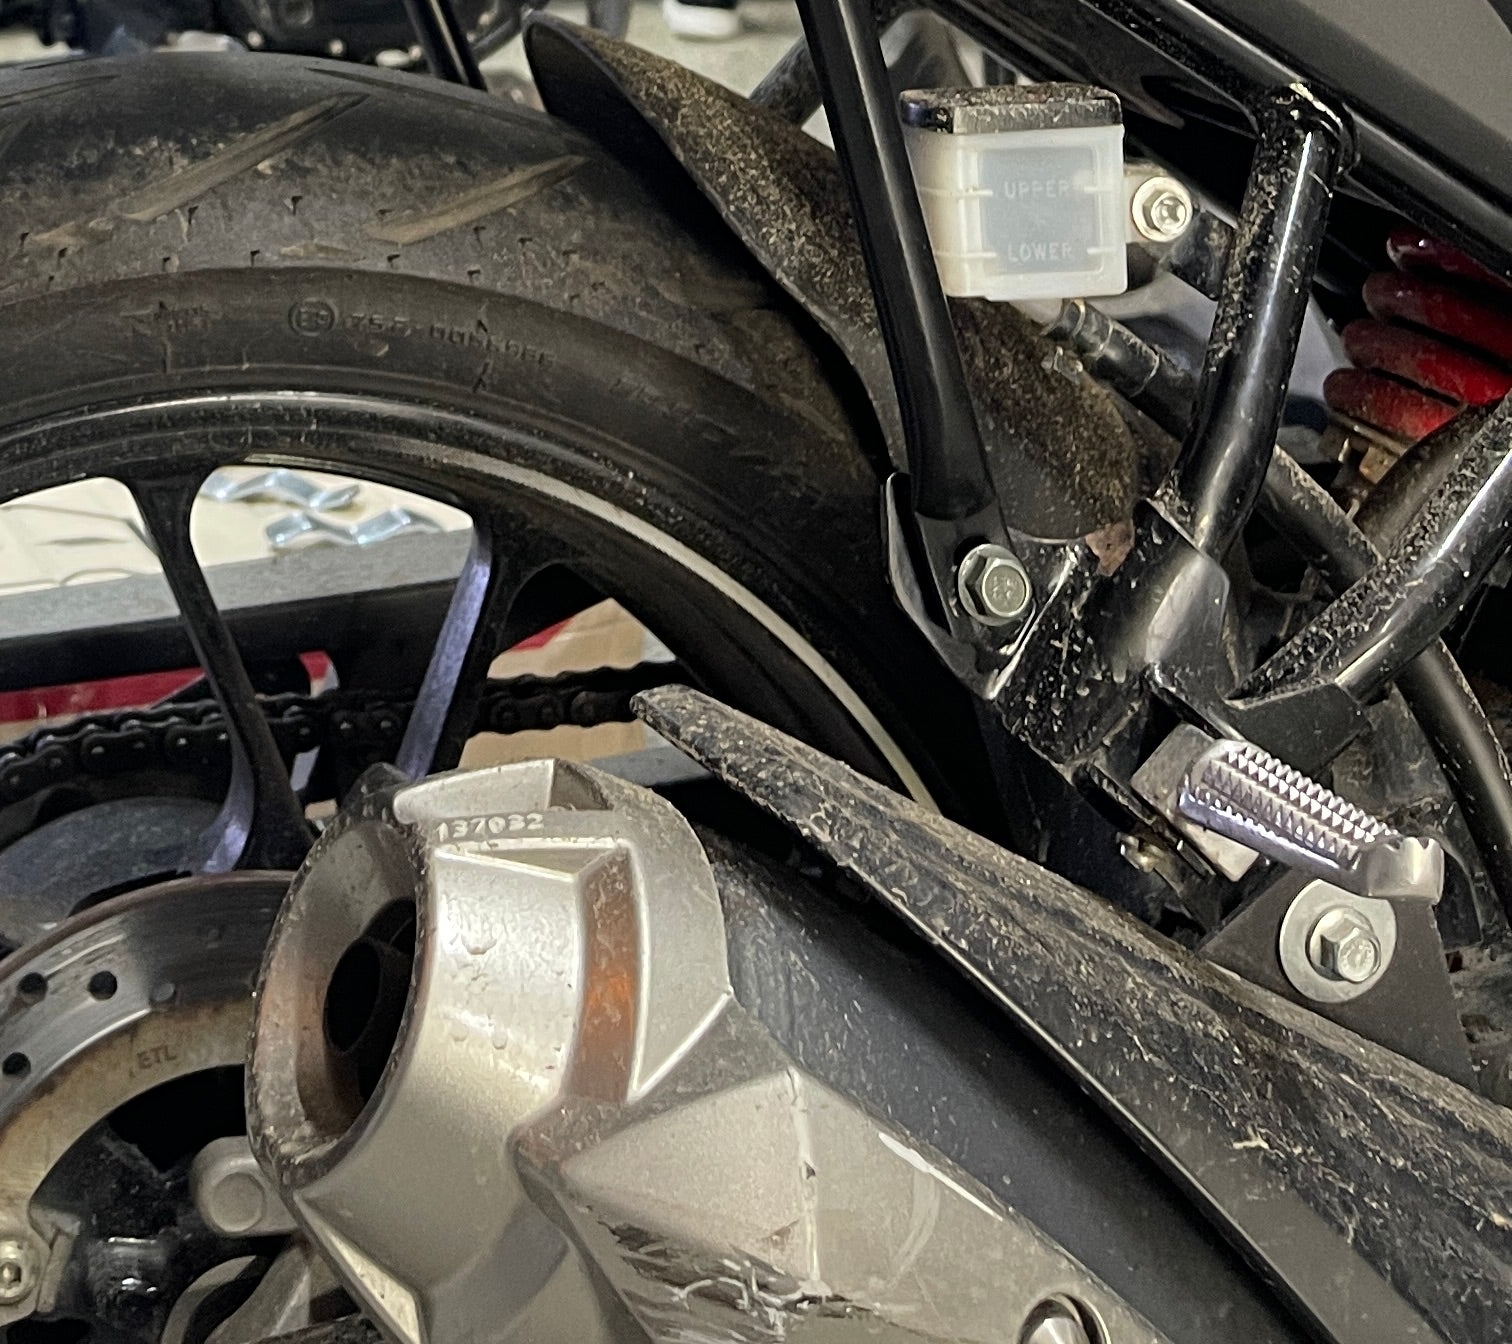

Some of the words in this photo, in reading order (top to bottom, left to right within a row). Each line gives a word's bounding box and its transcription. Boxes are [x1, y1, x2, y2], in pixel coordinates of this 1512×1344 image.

[1003, 179, 1071, 200] UPPER
[1007, 241, 1073, 263] LOWER
[434, 812, 545, 843] 137032
